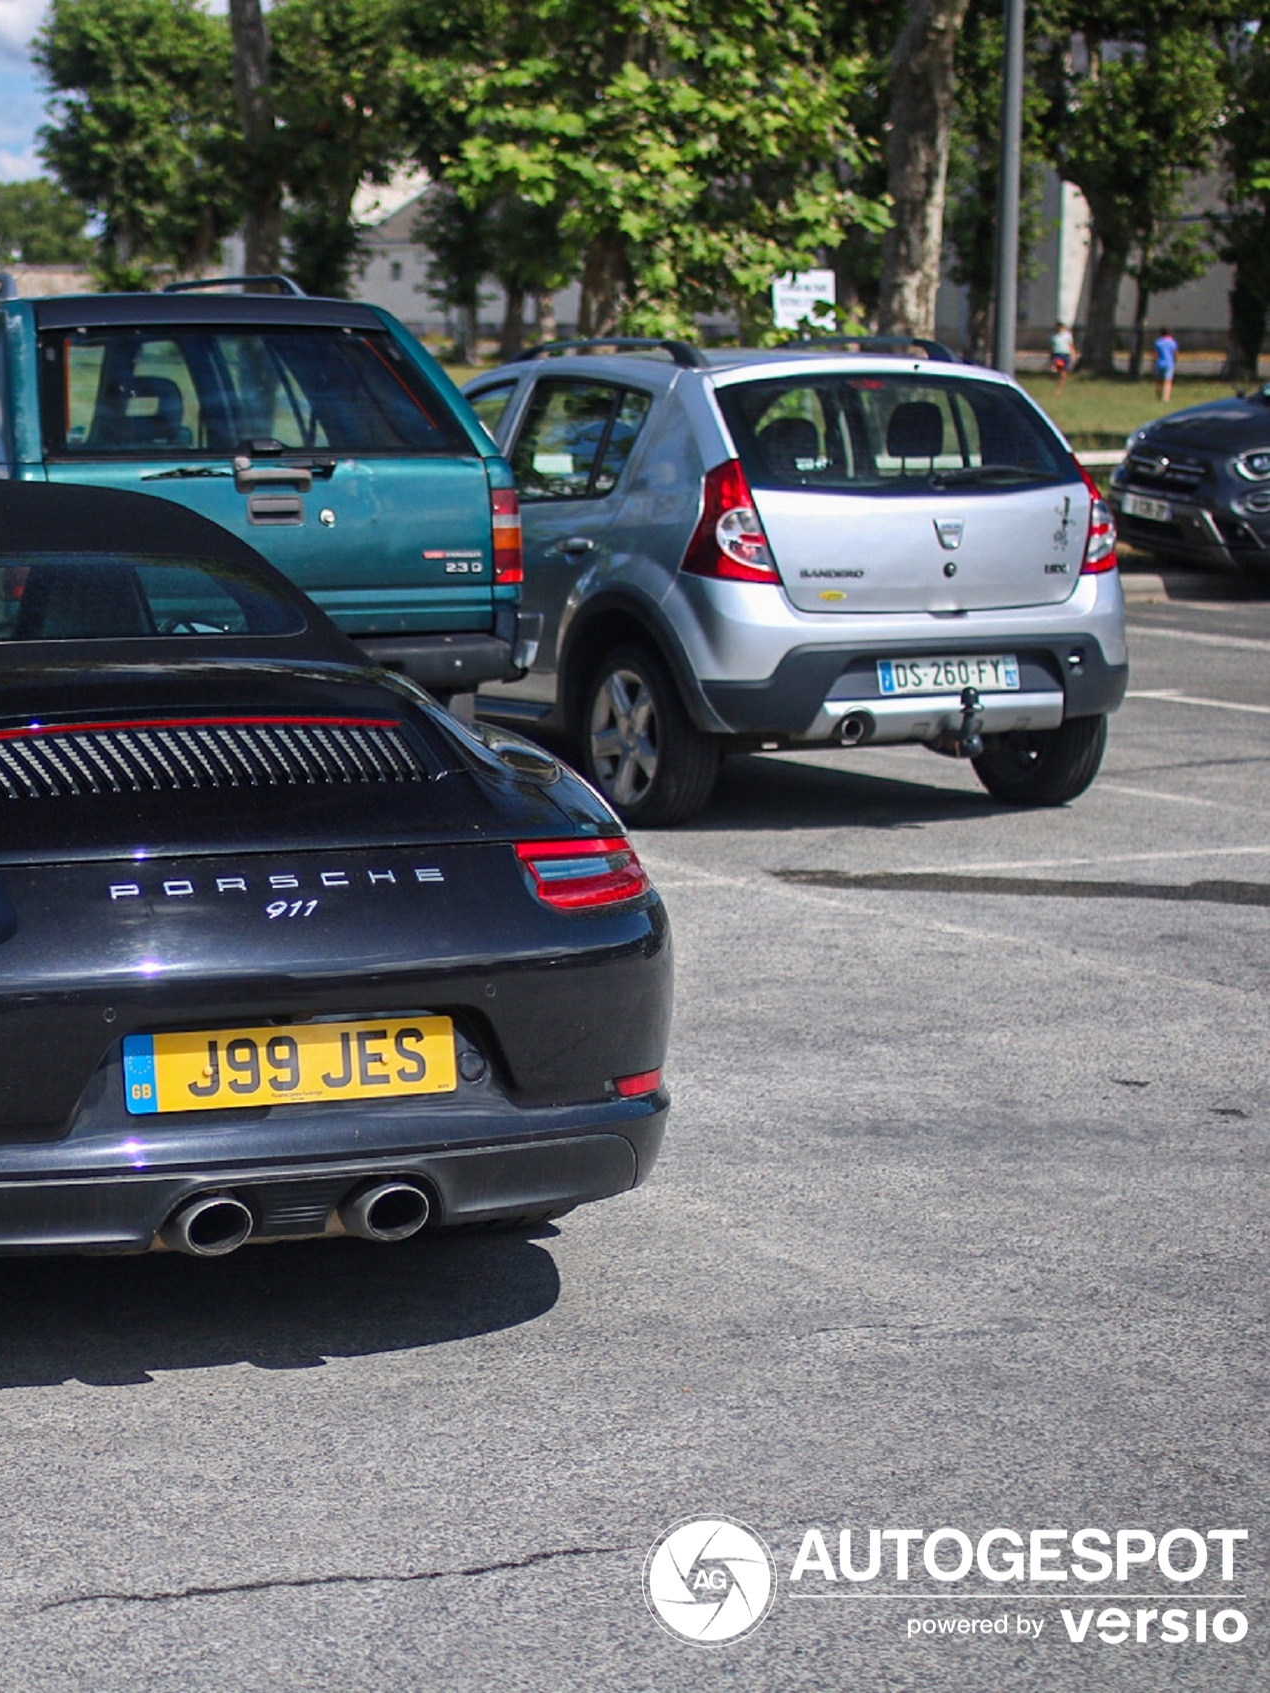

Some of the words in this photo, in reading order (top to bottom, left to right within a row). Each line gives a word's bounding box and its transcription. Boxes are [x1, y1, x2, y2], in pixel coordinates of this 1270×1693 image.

[109, 868, 445, 899] PORSCHE
[265, 900, 318, 919] 911
[187, 1036, 300, 1098] J99
[321, 1027, 427, 1088] JES
[131, 1083, 152, 1100] GB
